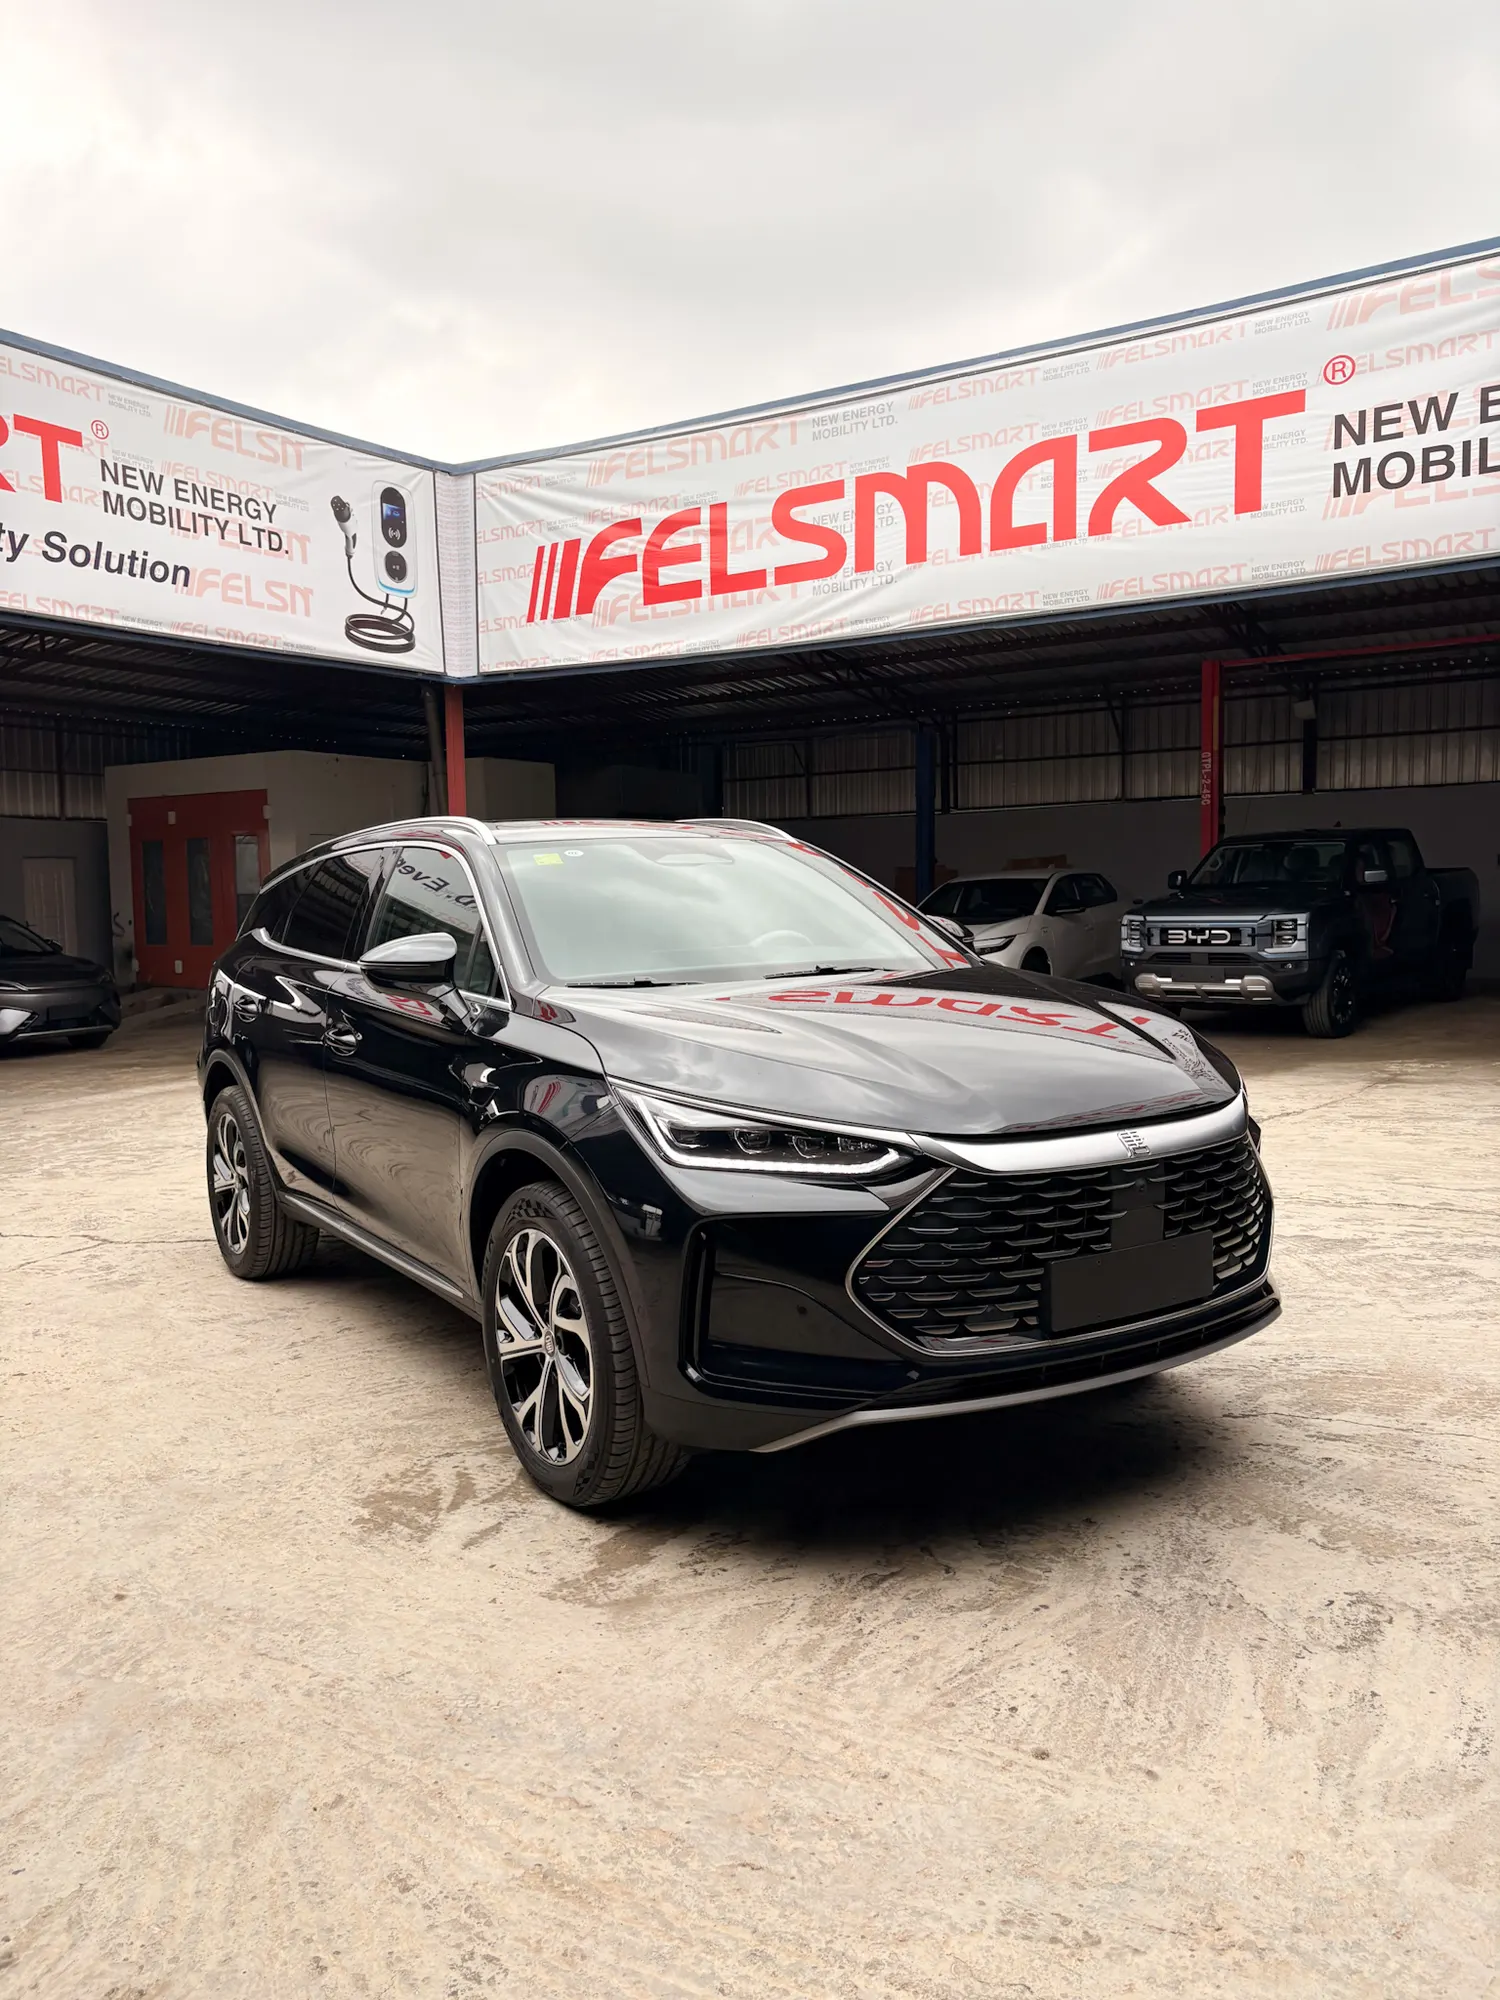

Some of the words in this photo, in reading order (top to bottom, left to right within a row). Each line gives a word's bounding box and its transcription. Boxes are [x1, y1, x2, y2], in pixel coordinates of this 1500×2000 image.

[1255, 318, 1273, 329] NEW
[1275, 311, 1309, 325] ENERGY
[1255, 321, 1292, 335] MOBILITY
[1096, 320, 1251, 371] FELSMART
[908, 367, 1041, 411] FELSMART
[1252, 379, 1270, 390] NEW
[1273, 371, 1308, 386] ENERGY
[1252, 383, 1291, 397] MOBILITY
[812, 412, 839, 429] NEW
[842, 401, 894, 422] ENERGY
[1095, 379, 1249, 427] FELSMART
[812, 420, 869, 441] MOBILITY
[872, 414, 898, 429] LTD.
[1272, 429, 1306, 443] ENERGY
[1333, 391, 1460, 450] NEW
[586, 413, 807, 488] FELSMART
[908, 422, 1040, 463] FELSMART
[100, 458, 164, 496] NEW
[174, 478, 276, 523] ENERGY
[734, 460, 847, 497] FELSMART
[527, 389, 1306, 623] FELSMART
[1250, 506, 1288, 520] MOBILITY
[1271, 498, 1305, 511] ENERGY
[102, 490, 229, 540] MOBILITY
[239, 522, 289, 555] LTD.
[42, 531, 191, 588] Solution
[1251, 564, 1270, 574] NEW
[1272, 559, 1305, 571] ENERGY
[1315, 527, 1496, 573] FELSMART
[812, 578, 868, 597] MOBILITY
[872, 573, 898, 587] LTD.
[1096, 563, 1248, 601] FELSMART
[1251, 569, 1290, 581] MOBILITY
[909, 590, 1040, 624] FELSMART
[1168, 930, 1230, 943] BYD
